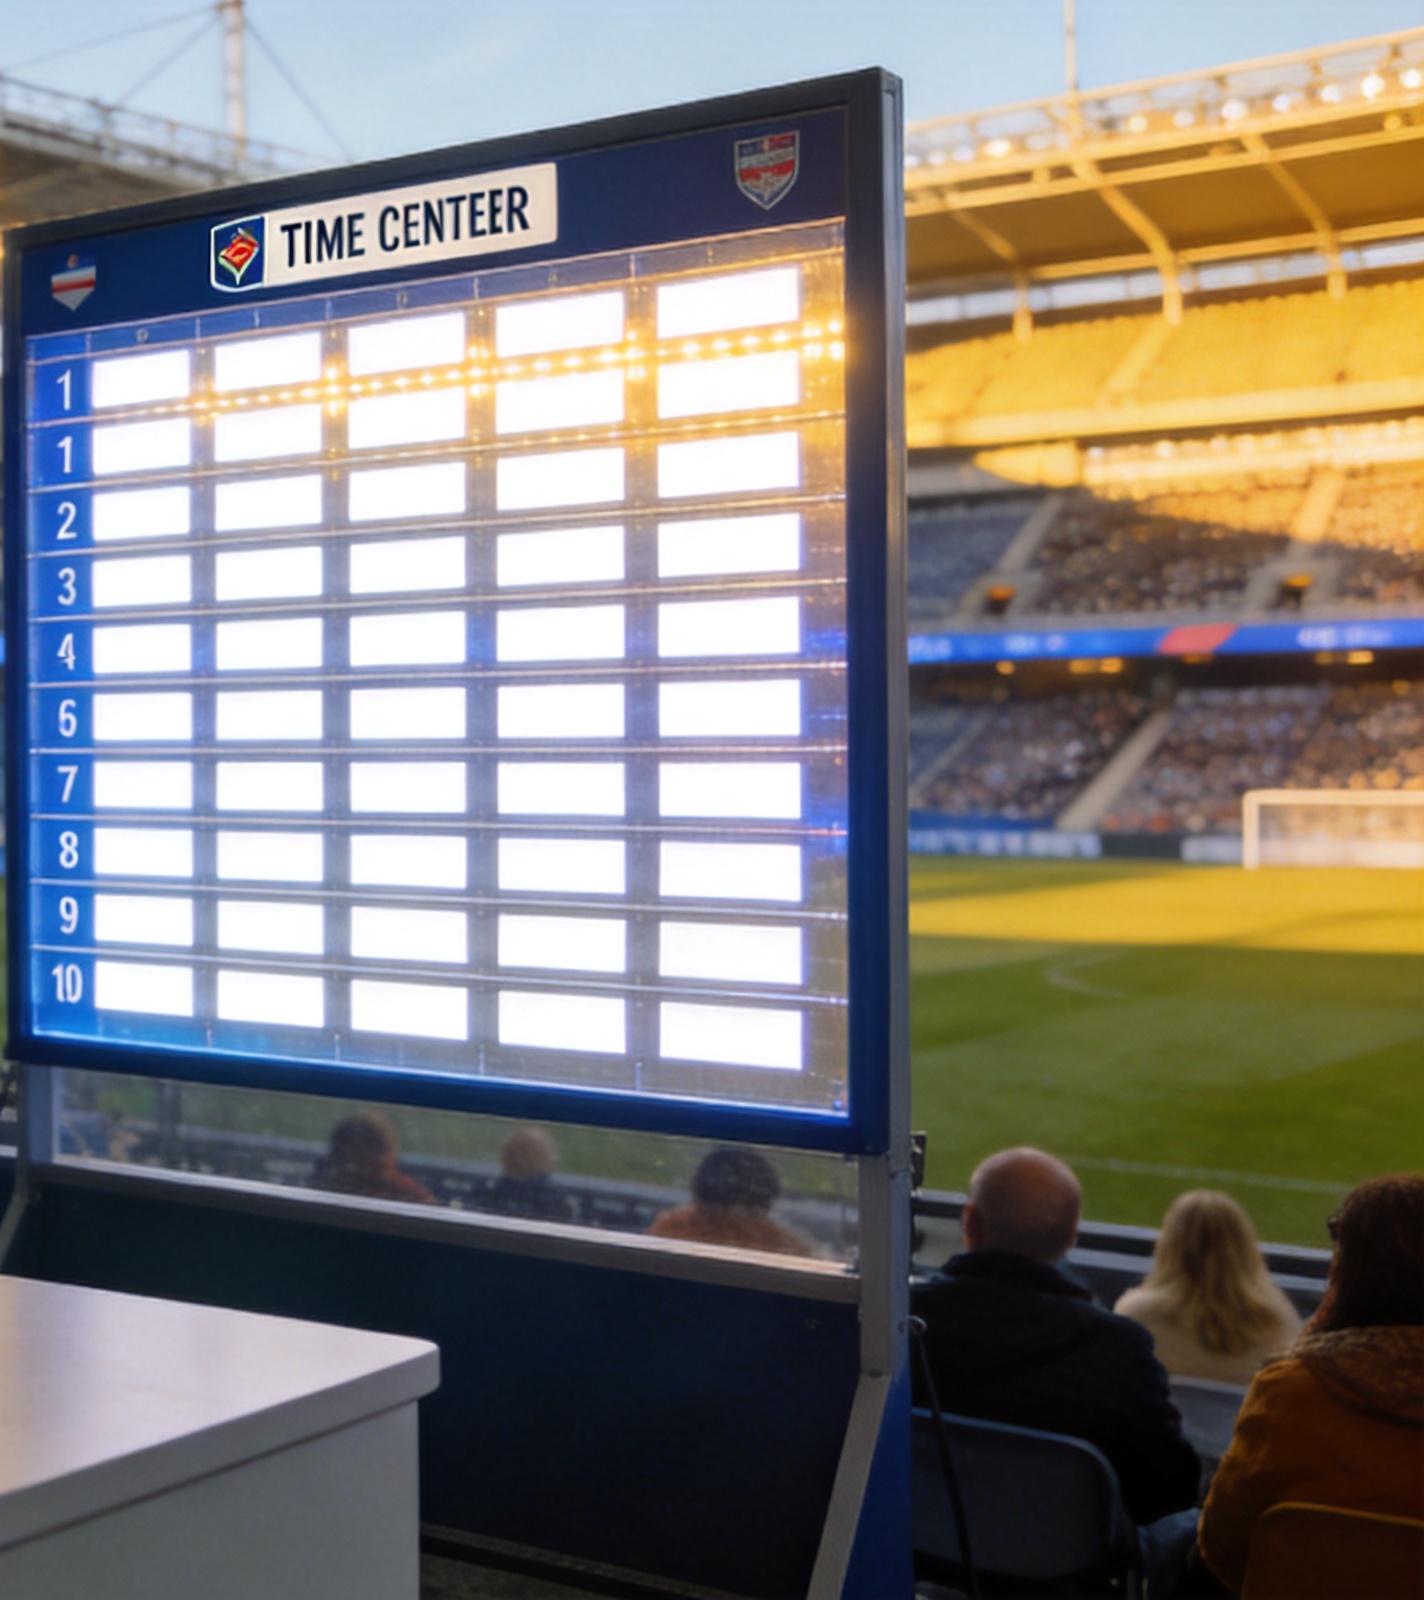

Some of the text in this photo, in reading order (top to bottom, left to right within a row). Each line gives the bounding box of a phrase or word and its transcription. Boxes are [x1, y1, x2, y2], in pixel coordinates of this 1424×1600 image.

[280, 186, 531, 268] TIME CENTEER
[56, 369, 72, 411] 1
[56, 436, 73, 474] 1
[56, 501, 78, 540] 2
[57, 567, 77, 606] 3
[56, 632, 76, 671] 4
[58, 699, 78, 738] 6
[56, 765, 79, 803] 7
[59, 830, 79, 869] 8
[59, 896, 79, 935] 9
[51, 963, 84, 1004] 10
